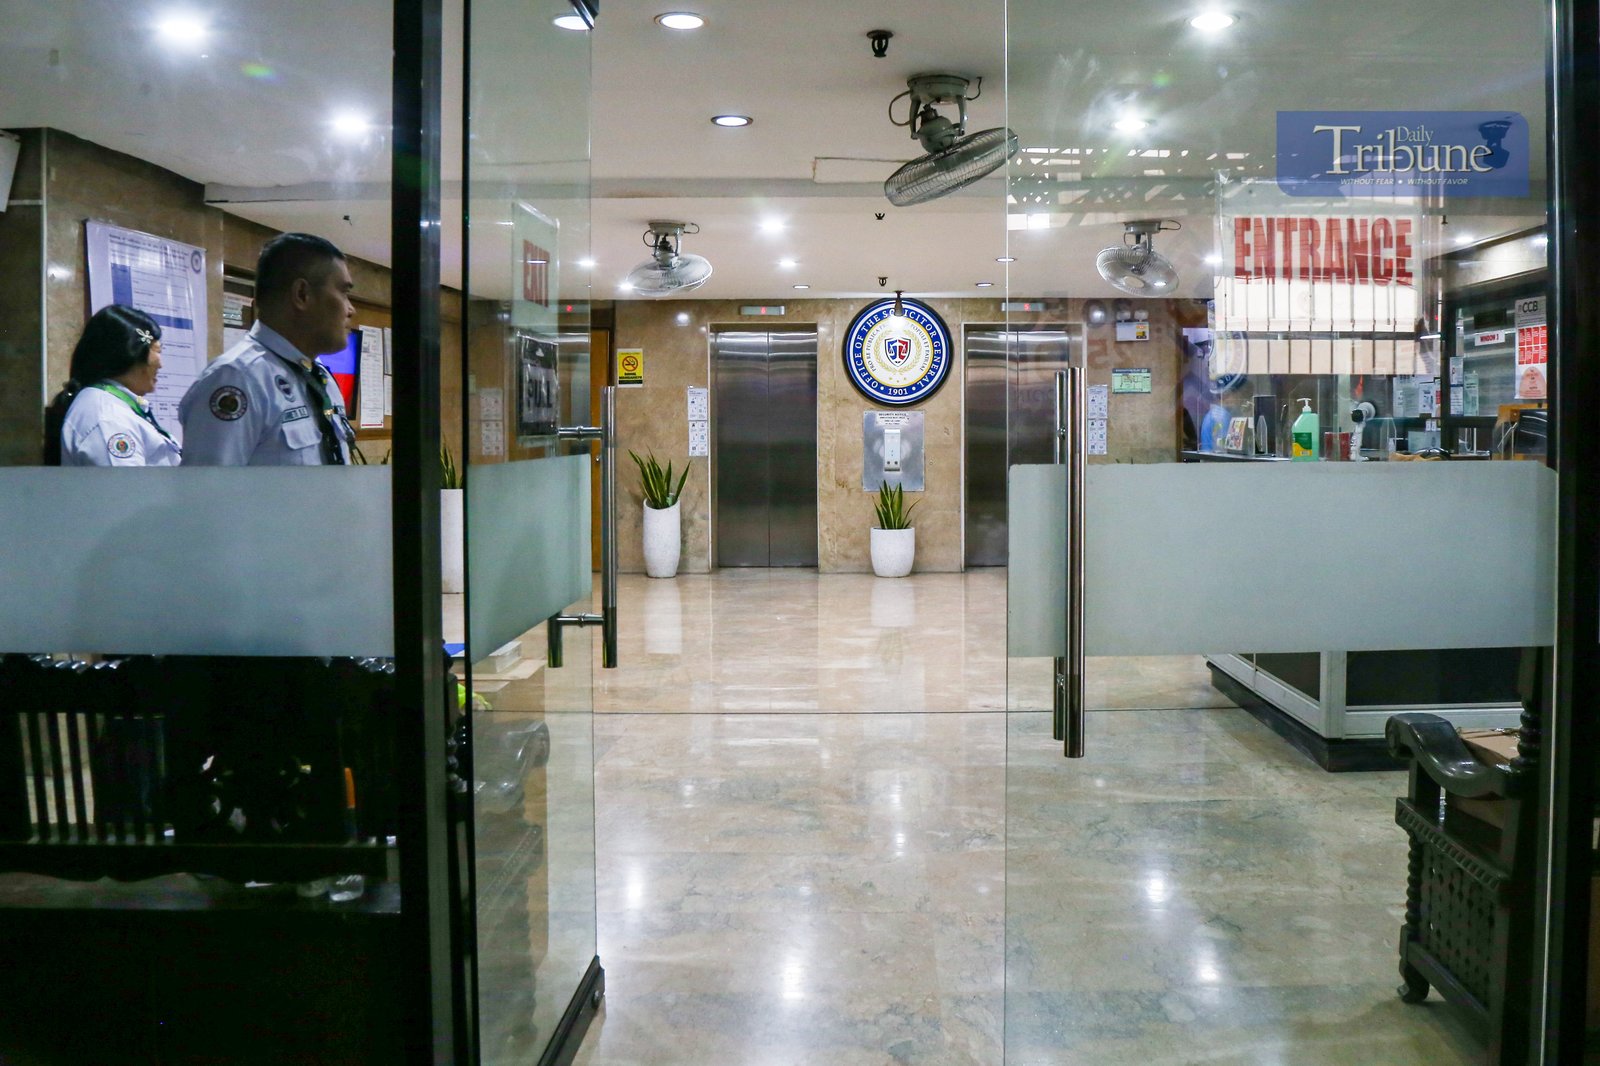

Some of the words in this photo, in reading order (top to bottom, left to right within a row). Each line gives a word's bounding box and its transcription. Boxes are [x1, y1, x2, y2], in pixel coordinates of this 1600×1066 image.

[1234, 217, 1413, 286] ENTRANCE
[1522, 300, 1538, 312] CCB
[861, 314, 881, 332] THE
[882, 308, 937, 339] SOICITOR
[855, 336, 864, 349] OF
[854, 353, 879, 389] OFFICE
[917, 340, 942, 388] GENERAL
[888, 388, 908, 396] 1901
